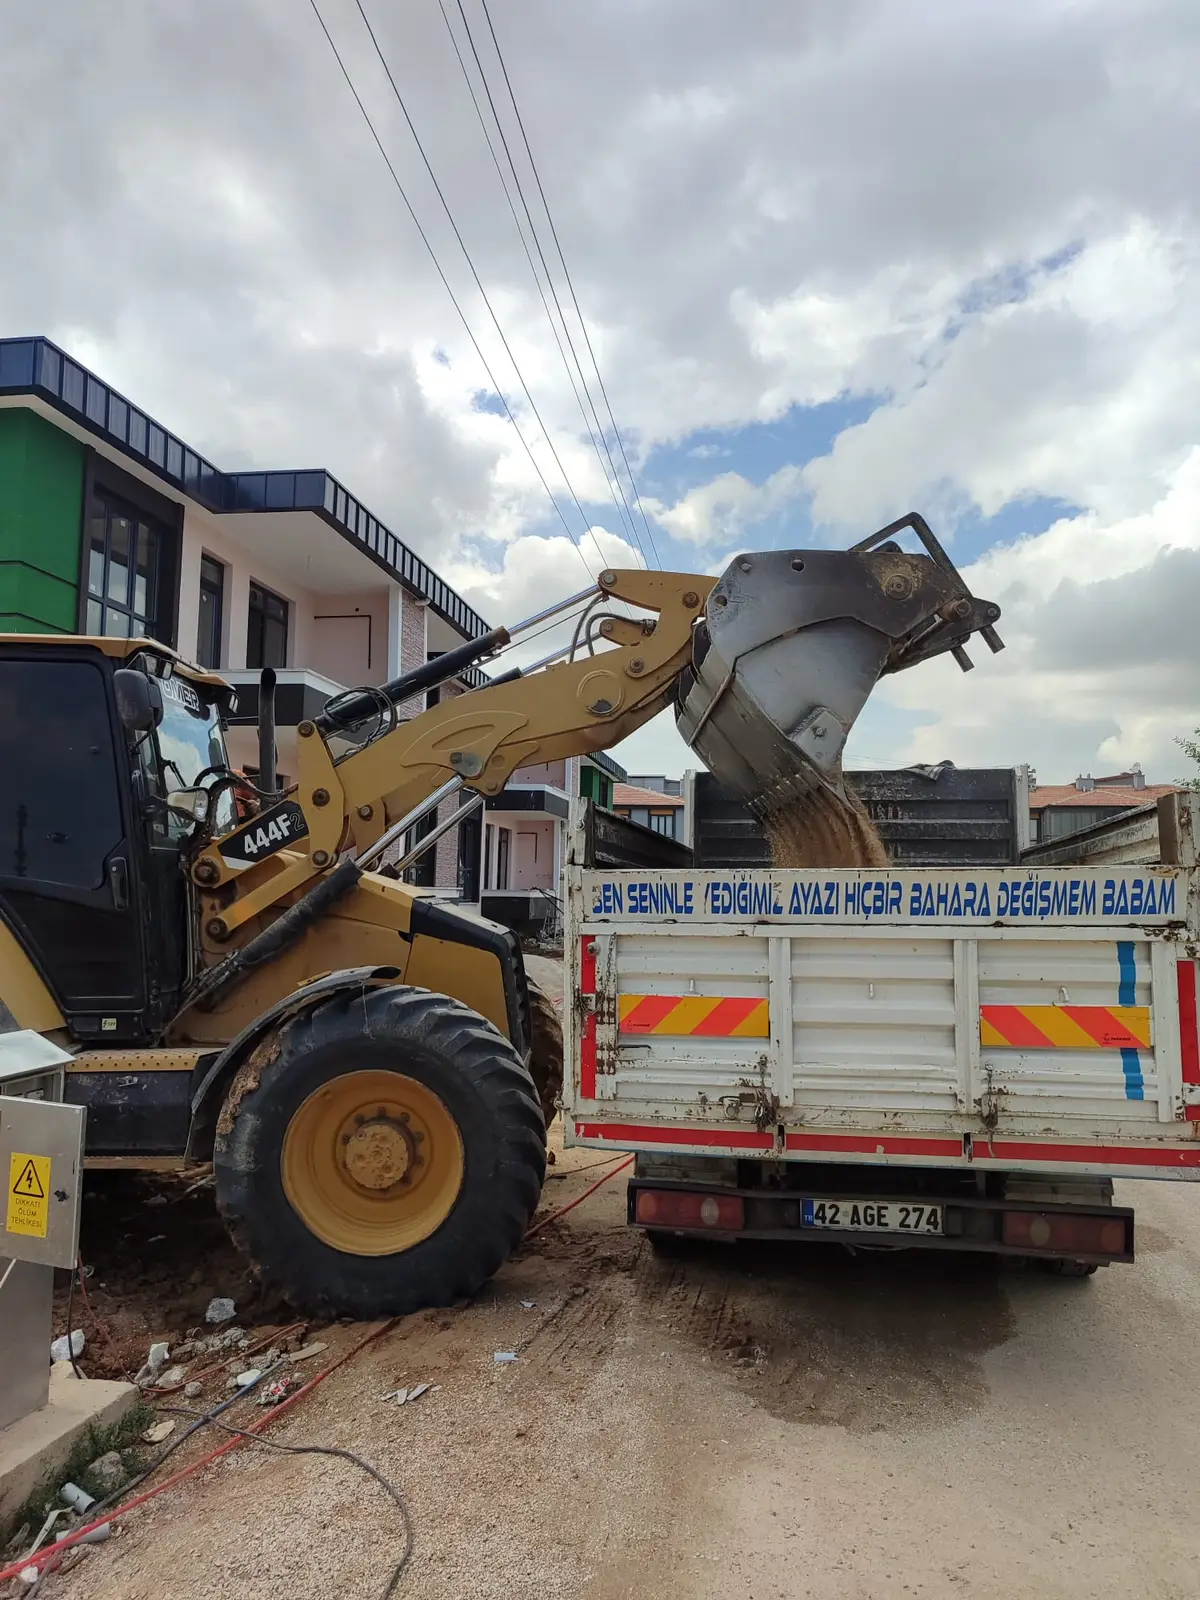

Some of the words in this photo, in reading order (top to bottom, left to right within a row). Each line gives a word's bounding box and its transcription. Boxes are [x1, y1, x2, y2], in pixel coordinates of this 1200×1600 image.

[244, 812, 305, 855] 444F2
[628, 875, 694, 915] SENİNLE
[788, 881, 839, 915] AYAZI
[844, 873, 903, 920] HİÇBİR
[909, 881, 992, 917] BAHARA
[996, 873, 1097, 920] DEĞİŞMEM
[1102, 878, 1176, 916] BABAM
[803, 1214, 814, 1223] TR
[814, 1203, 841, 1225] 42
[849, 1204, 889, 1227] AGE
[898, 1206, 940, 1231] 274
